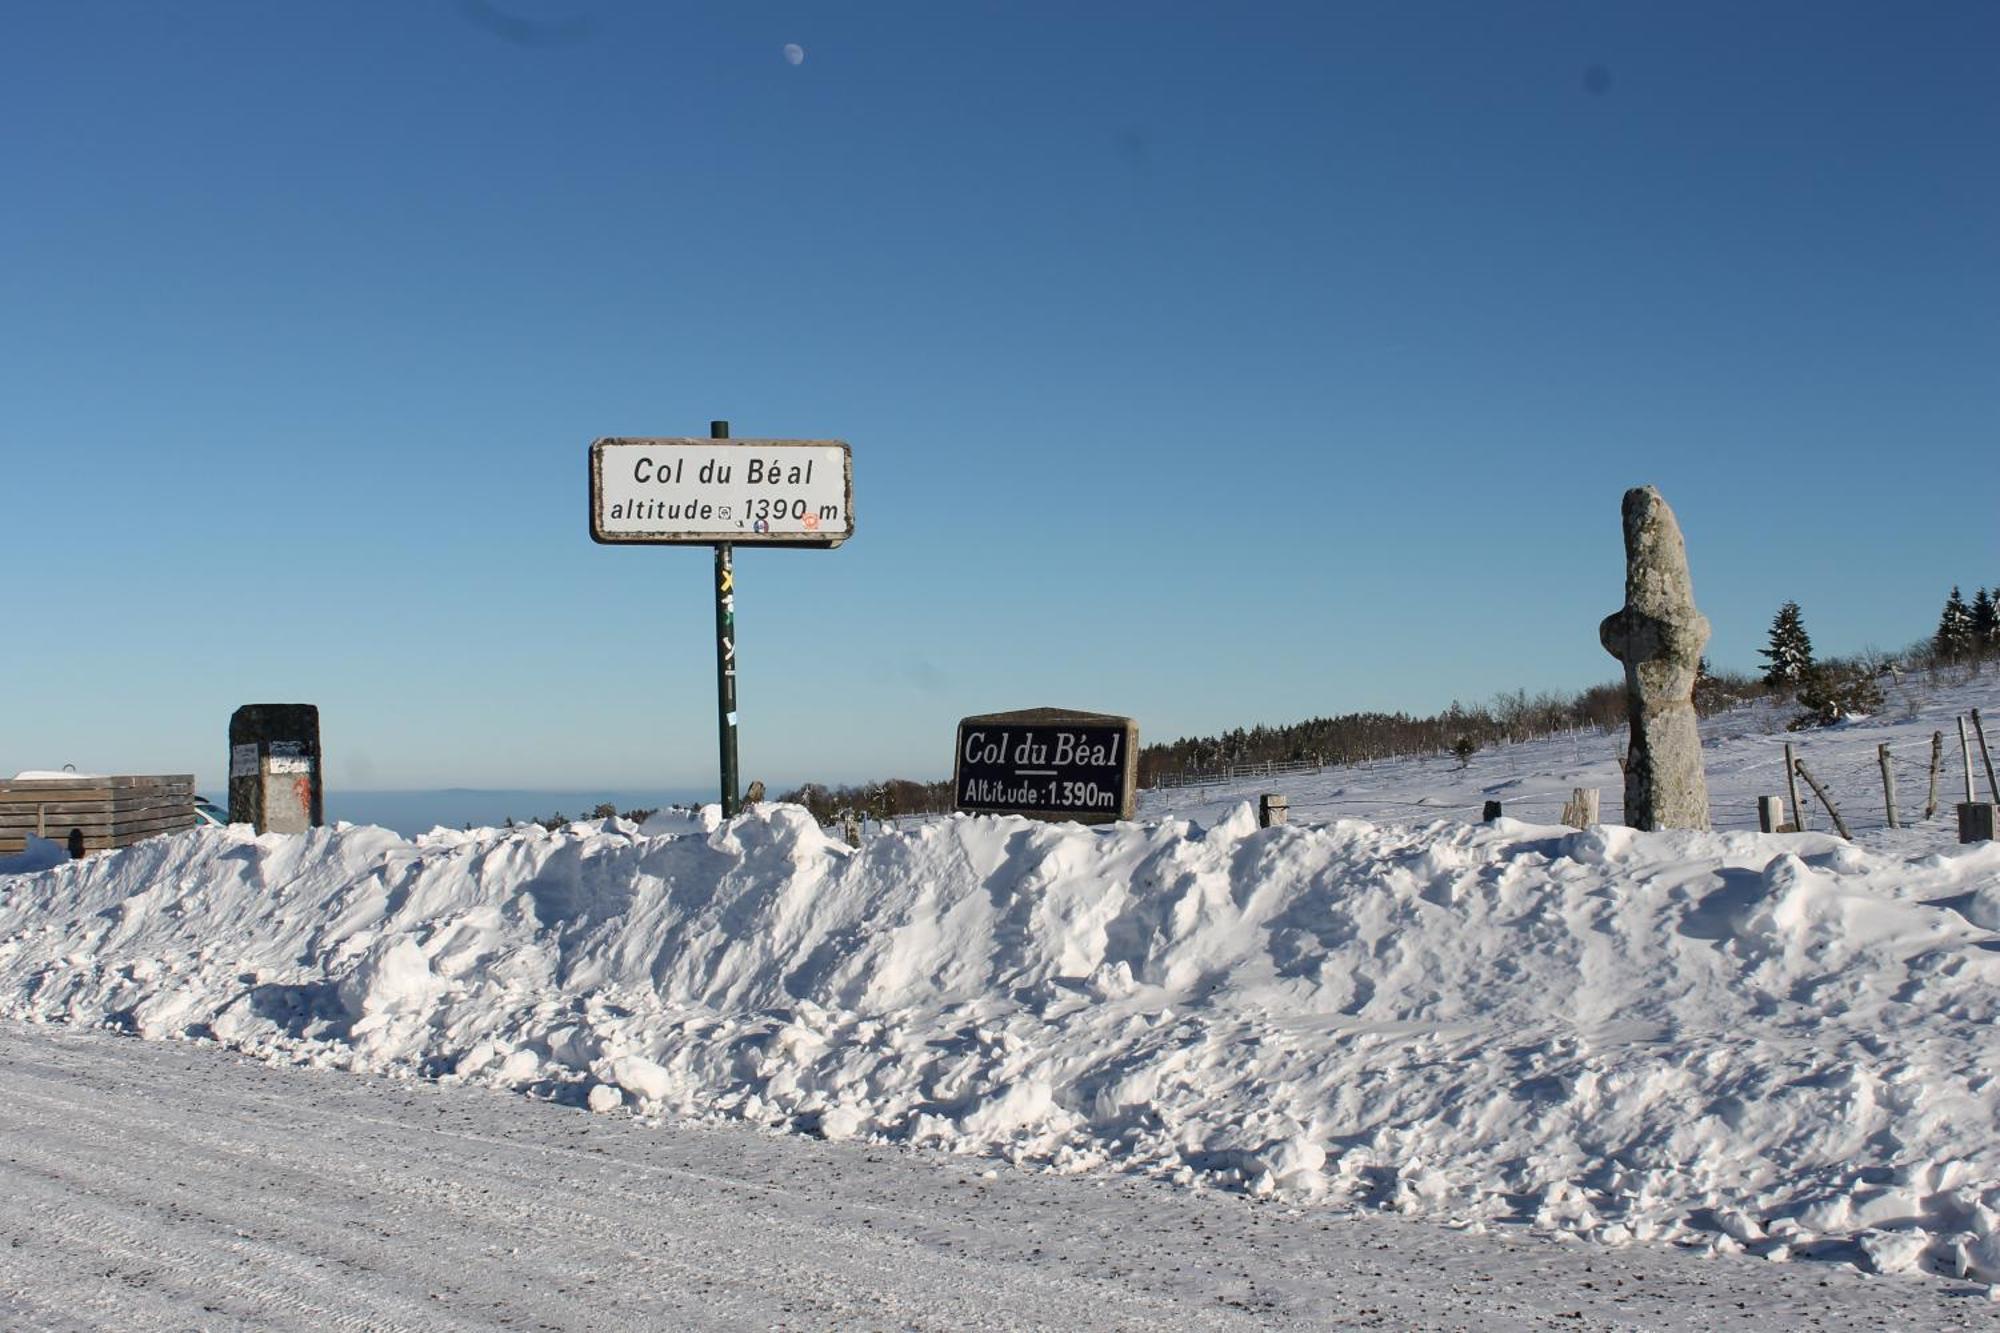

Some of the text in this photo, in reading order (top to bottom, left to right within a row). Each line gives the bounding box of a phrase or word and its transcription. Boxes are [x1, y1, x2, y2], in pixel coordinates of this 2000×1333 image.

[634, 457, 813, 485] Col du Béal
[611, 499, 838, 520] altitude 1390 m
[965, 732, 1121, 766] Col du Béal
